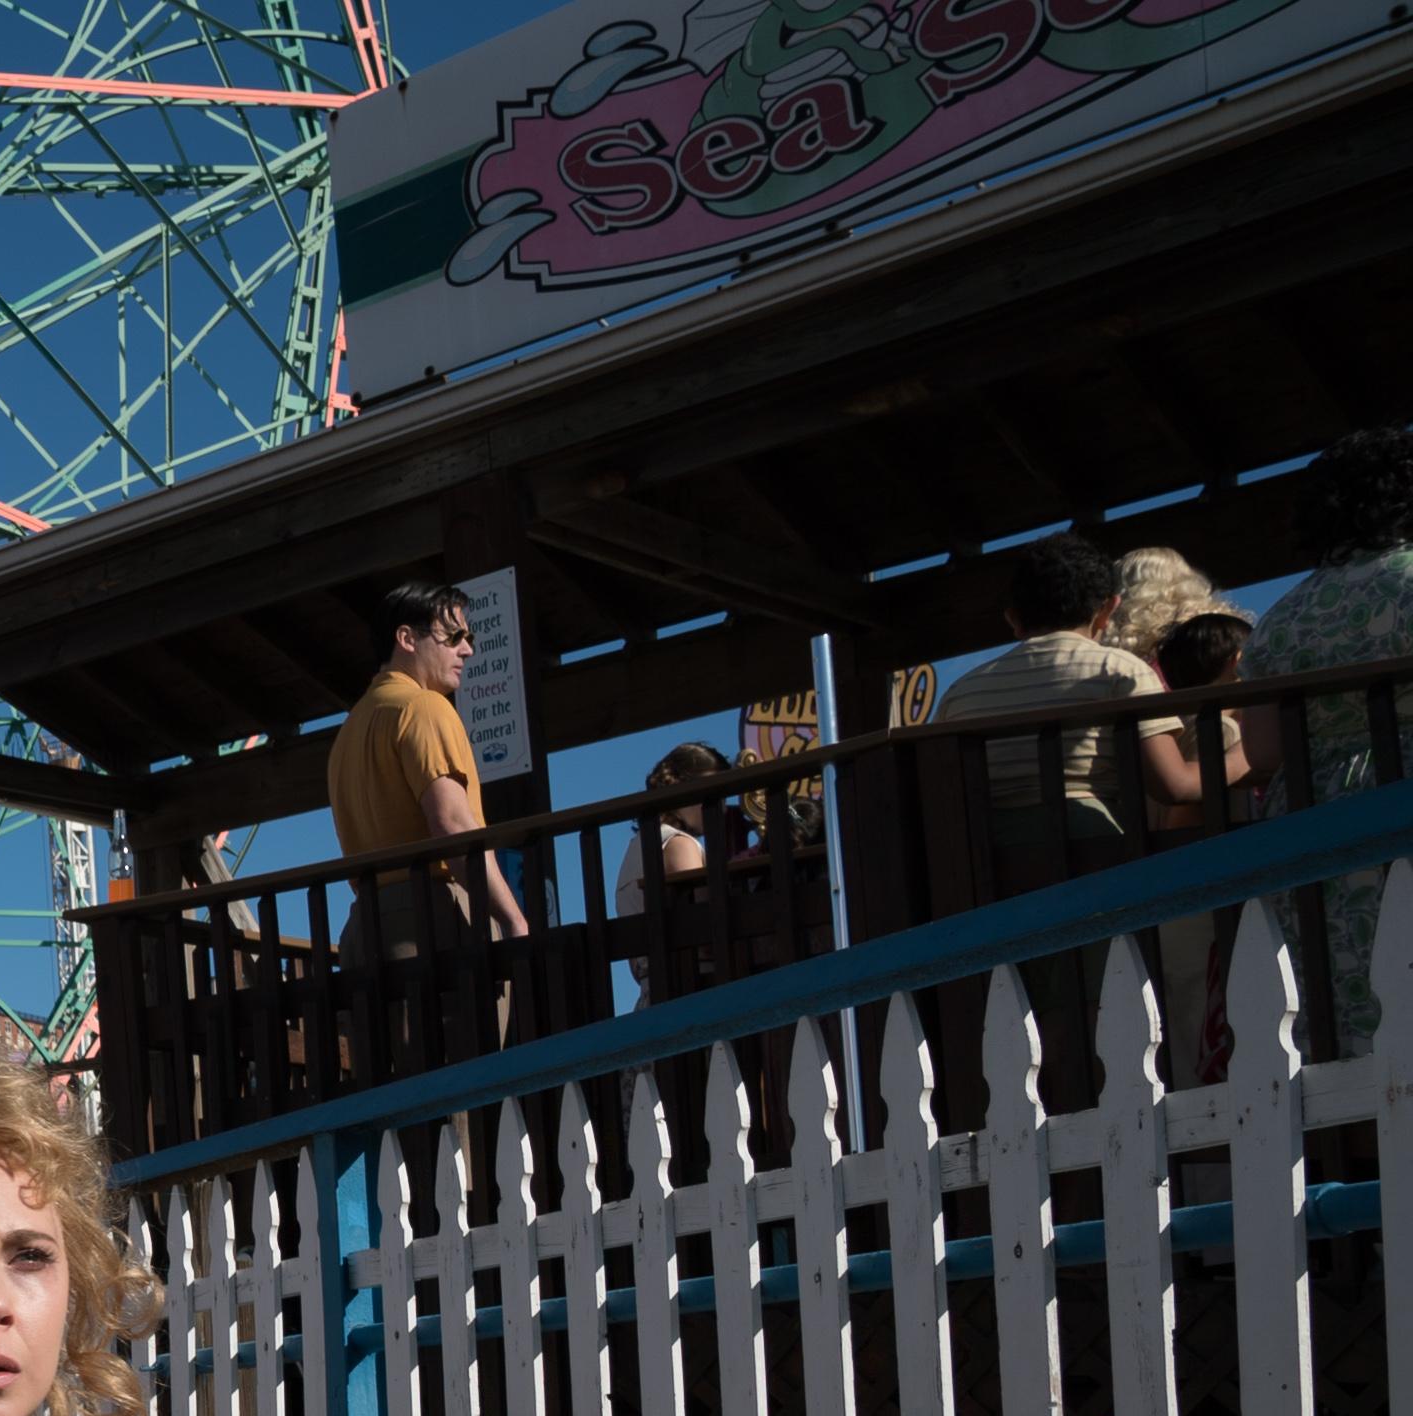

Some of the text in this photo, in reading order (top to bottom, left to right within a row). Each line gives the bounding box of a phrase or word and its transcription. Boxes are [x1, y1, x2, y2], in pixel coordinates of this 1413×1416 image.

[558, 74, 880, 234] Sea
[479, 633, 509, 653] smile
[467, 657, 509, 679] and say
[472, 700, 511, 723] for the
[469, 719, 516, 744] Camera!
